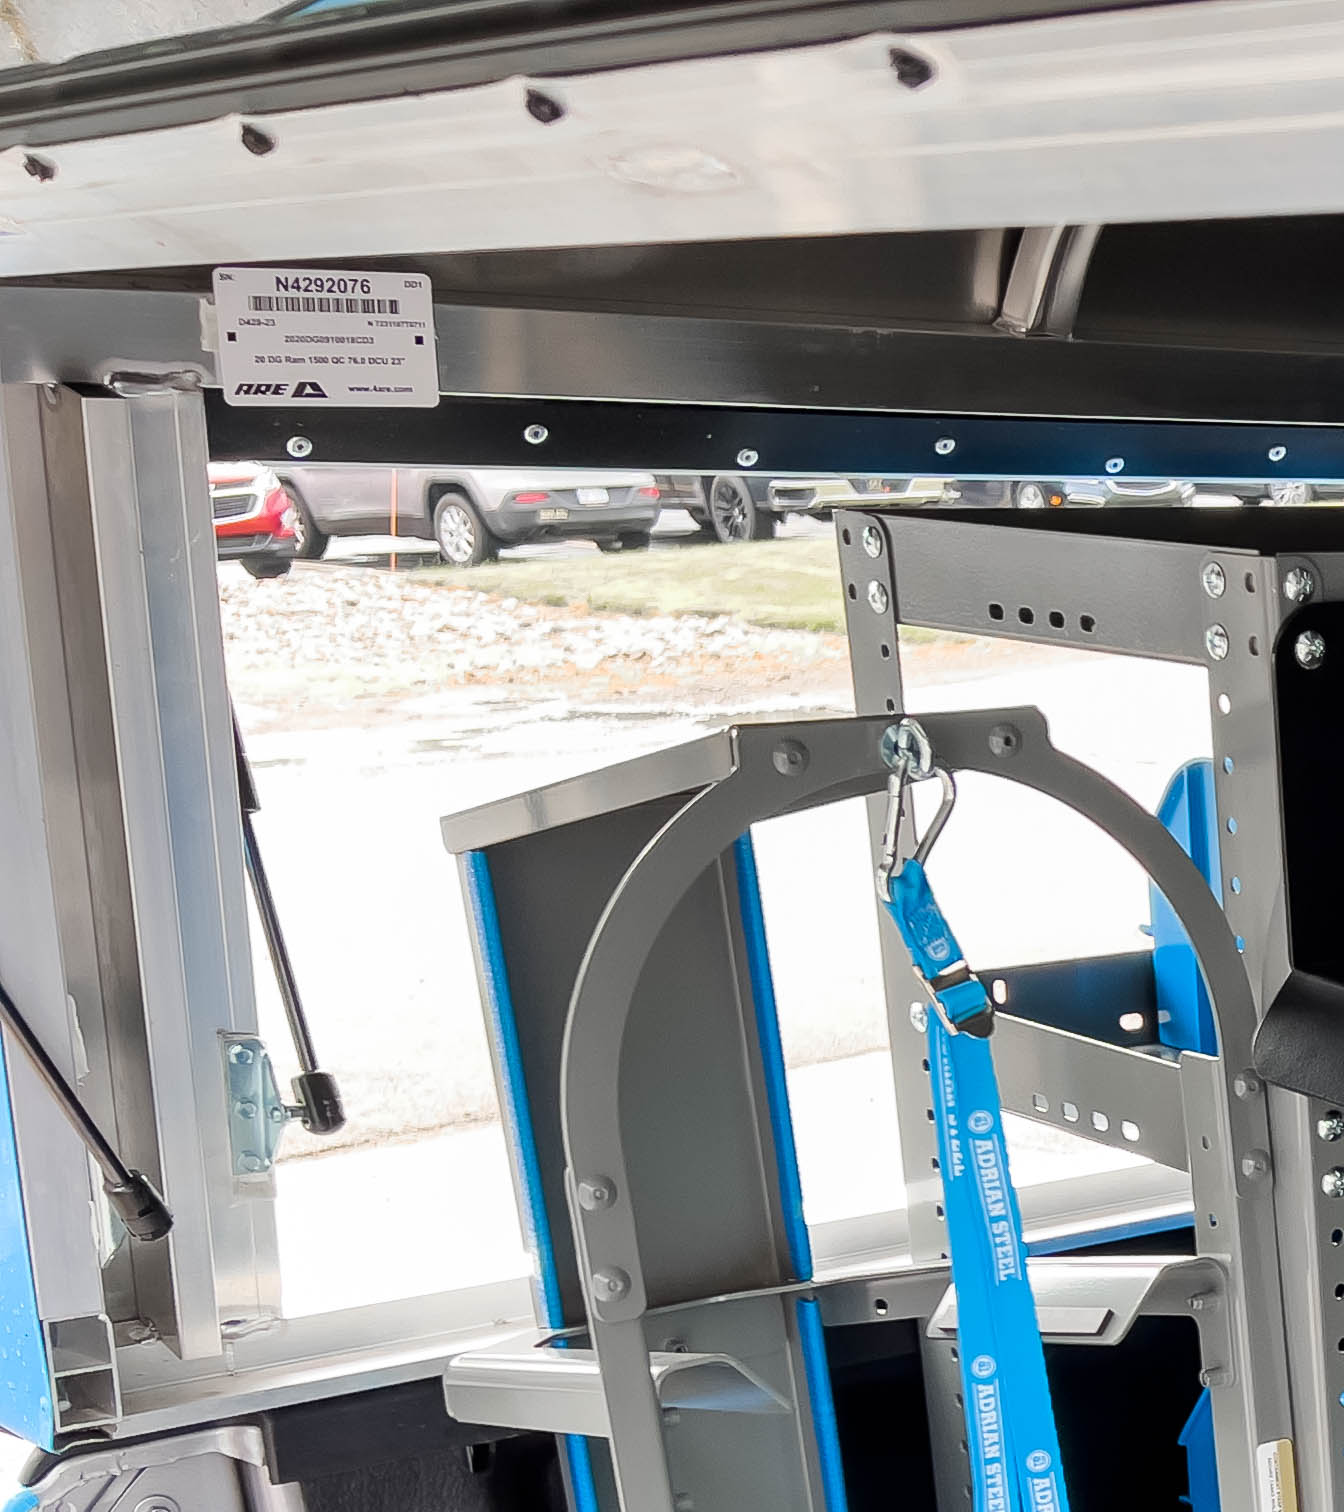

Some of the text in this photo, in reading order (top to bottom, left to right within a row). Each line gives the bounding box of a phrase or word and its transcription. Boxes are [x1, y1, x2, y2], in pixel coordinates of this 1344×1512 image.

[275, 276, 371, 294] N4292076
[285, 356, 306, 364] Ram
[234, 383, 289, 396] ARE
[974, 1139, 1017, 1281] ADRIAN STEEL
[976, 1384, 1001, 1459] ADRIAN
